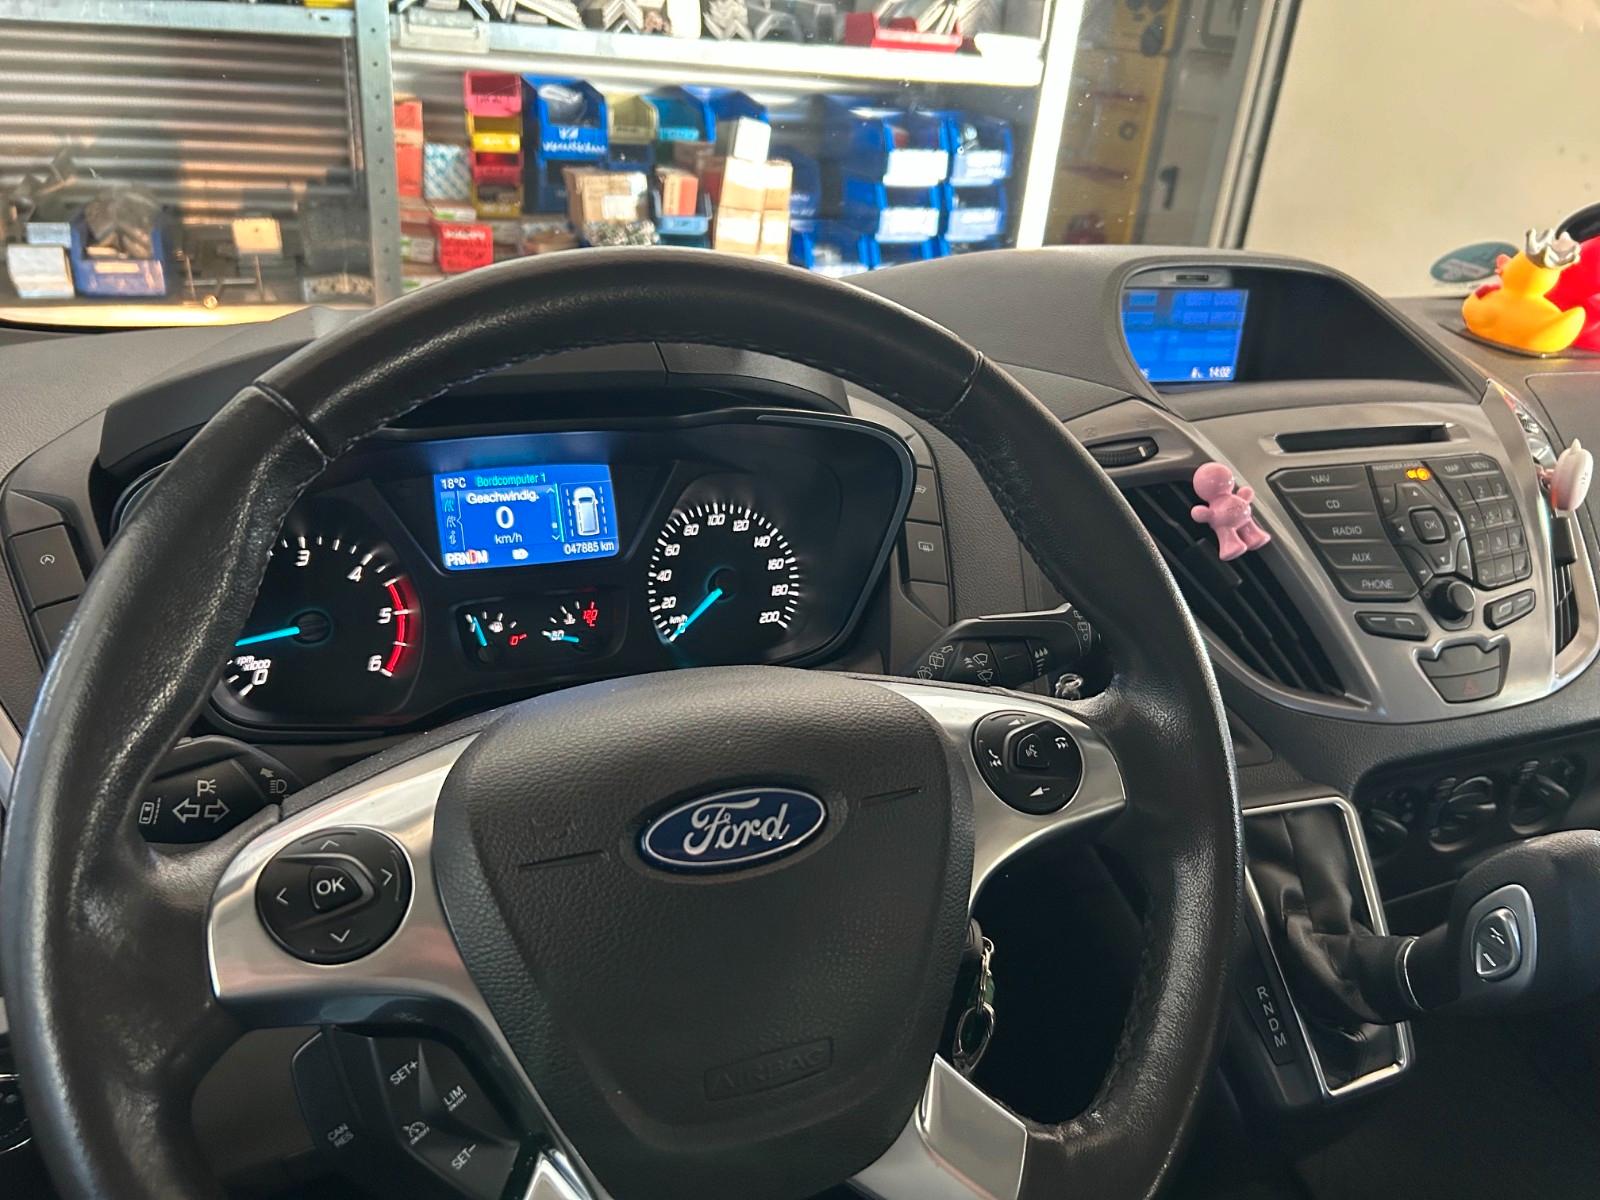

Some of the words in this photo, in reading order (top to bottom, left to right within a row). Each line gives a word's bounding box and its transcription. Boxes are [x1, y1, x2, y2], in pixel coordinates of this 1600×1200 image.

[441, 476, 466, 490] 18°C
[476, 474, 538, 488] Bordcomputer
[540, 472, 546, 482] 1
[1310, 474, 1331, 484] NAV
[466, 489, 540, 505] Geschwindig.
[1326, 499, 1340, 509] CD
[495, 506, 515, 528] 0
[707, 514, 726, 526] 100
[683, 524, 700, 536] 80
[732, 520, 750, 532] 120
[1332, 526, 1362, 536] RADIO
[1424, 520, 1438, 530] OK
[494, 534, 523, 544] km/h
[754, 535, 770, 548] 140
[563, 541, 600, 555] 047885
[600, 540, 614, 551] km
[664, 544, 680, 556] 60
[294, 550, 310, 566] 3
[444, 549, 489, 567] PRNDM
[1351, 552, 1371, 562] AUX
[768, 558, 784, 570] 160
[346, 566, 363, 582] 4
[656, 570, 672, 582] 40
[771, 584, 788, 596] 180
[1361, 578, 1394, 590] PHONE
[661, 596, 677, 609] 20
[377, 607, 392, 624] 5
[668, 614, 688, 624] km/h
[759, 610, 780, 624] 200
[510, 636, 518, 646] 0
[236, 655, 254, 666] rpm
[367, 654, 382, 672] 6
[252, 668, 268, 685] 0
[683, 797, 790, 856] Ford
[316, 876, 346, 895] OK
[389, 1059, 418, 1086] SET+
[443, 1084, 464, 1106] LIM
[451, 1143, 477, 1170] SET-
